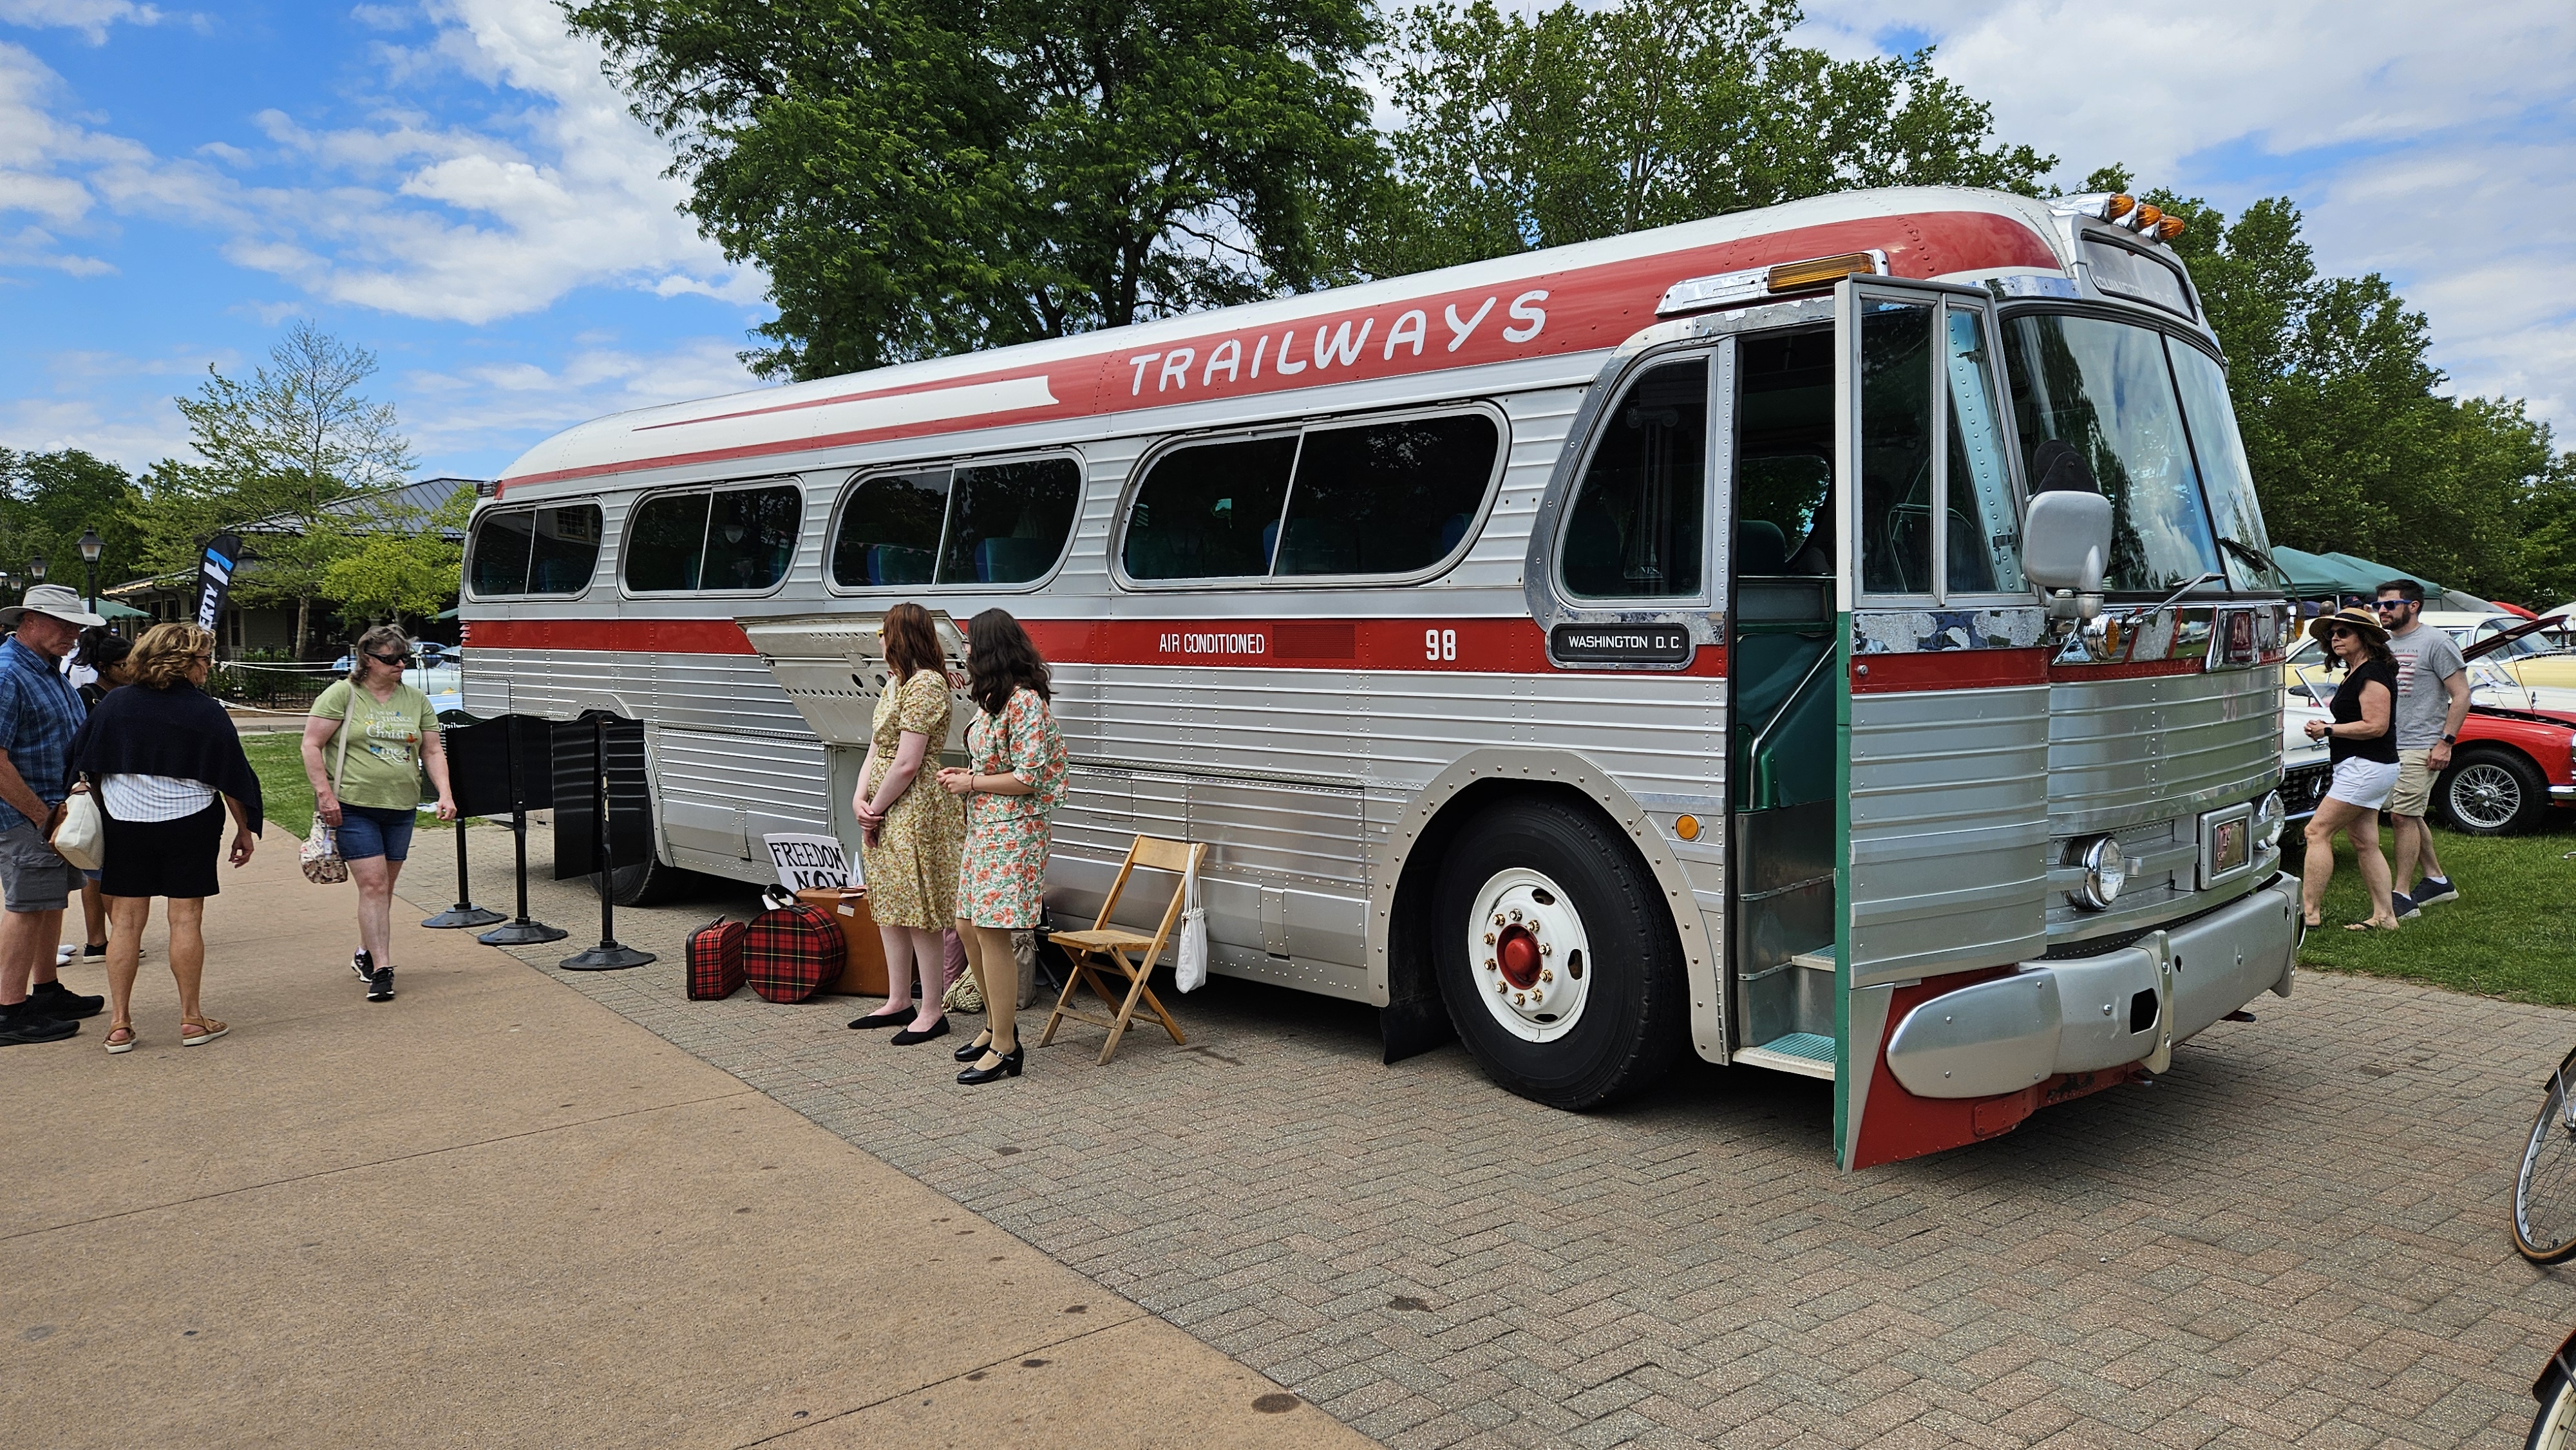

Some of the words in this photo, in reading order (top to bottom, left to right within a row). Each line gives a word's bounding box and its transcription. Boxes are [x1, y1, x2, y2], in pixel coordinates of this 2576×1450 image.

[1129, 290, 1549, 396] TRAILWAYS
[198, 582, 218, 634] ERTY
[1159, 634, 1180, 653] AIR
[1184, 634, 1265, 654] CONDITIONED
[1426, 629, 1456, 661] 98
[1569, 636, 1648, 648] WASHINGTON
[366, 720, 417, 740] Christ
[768, 842, 849, 872] FREEDOM
[793, 869, 849, 890] NOW
